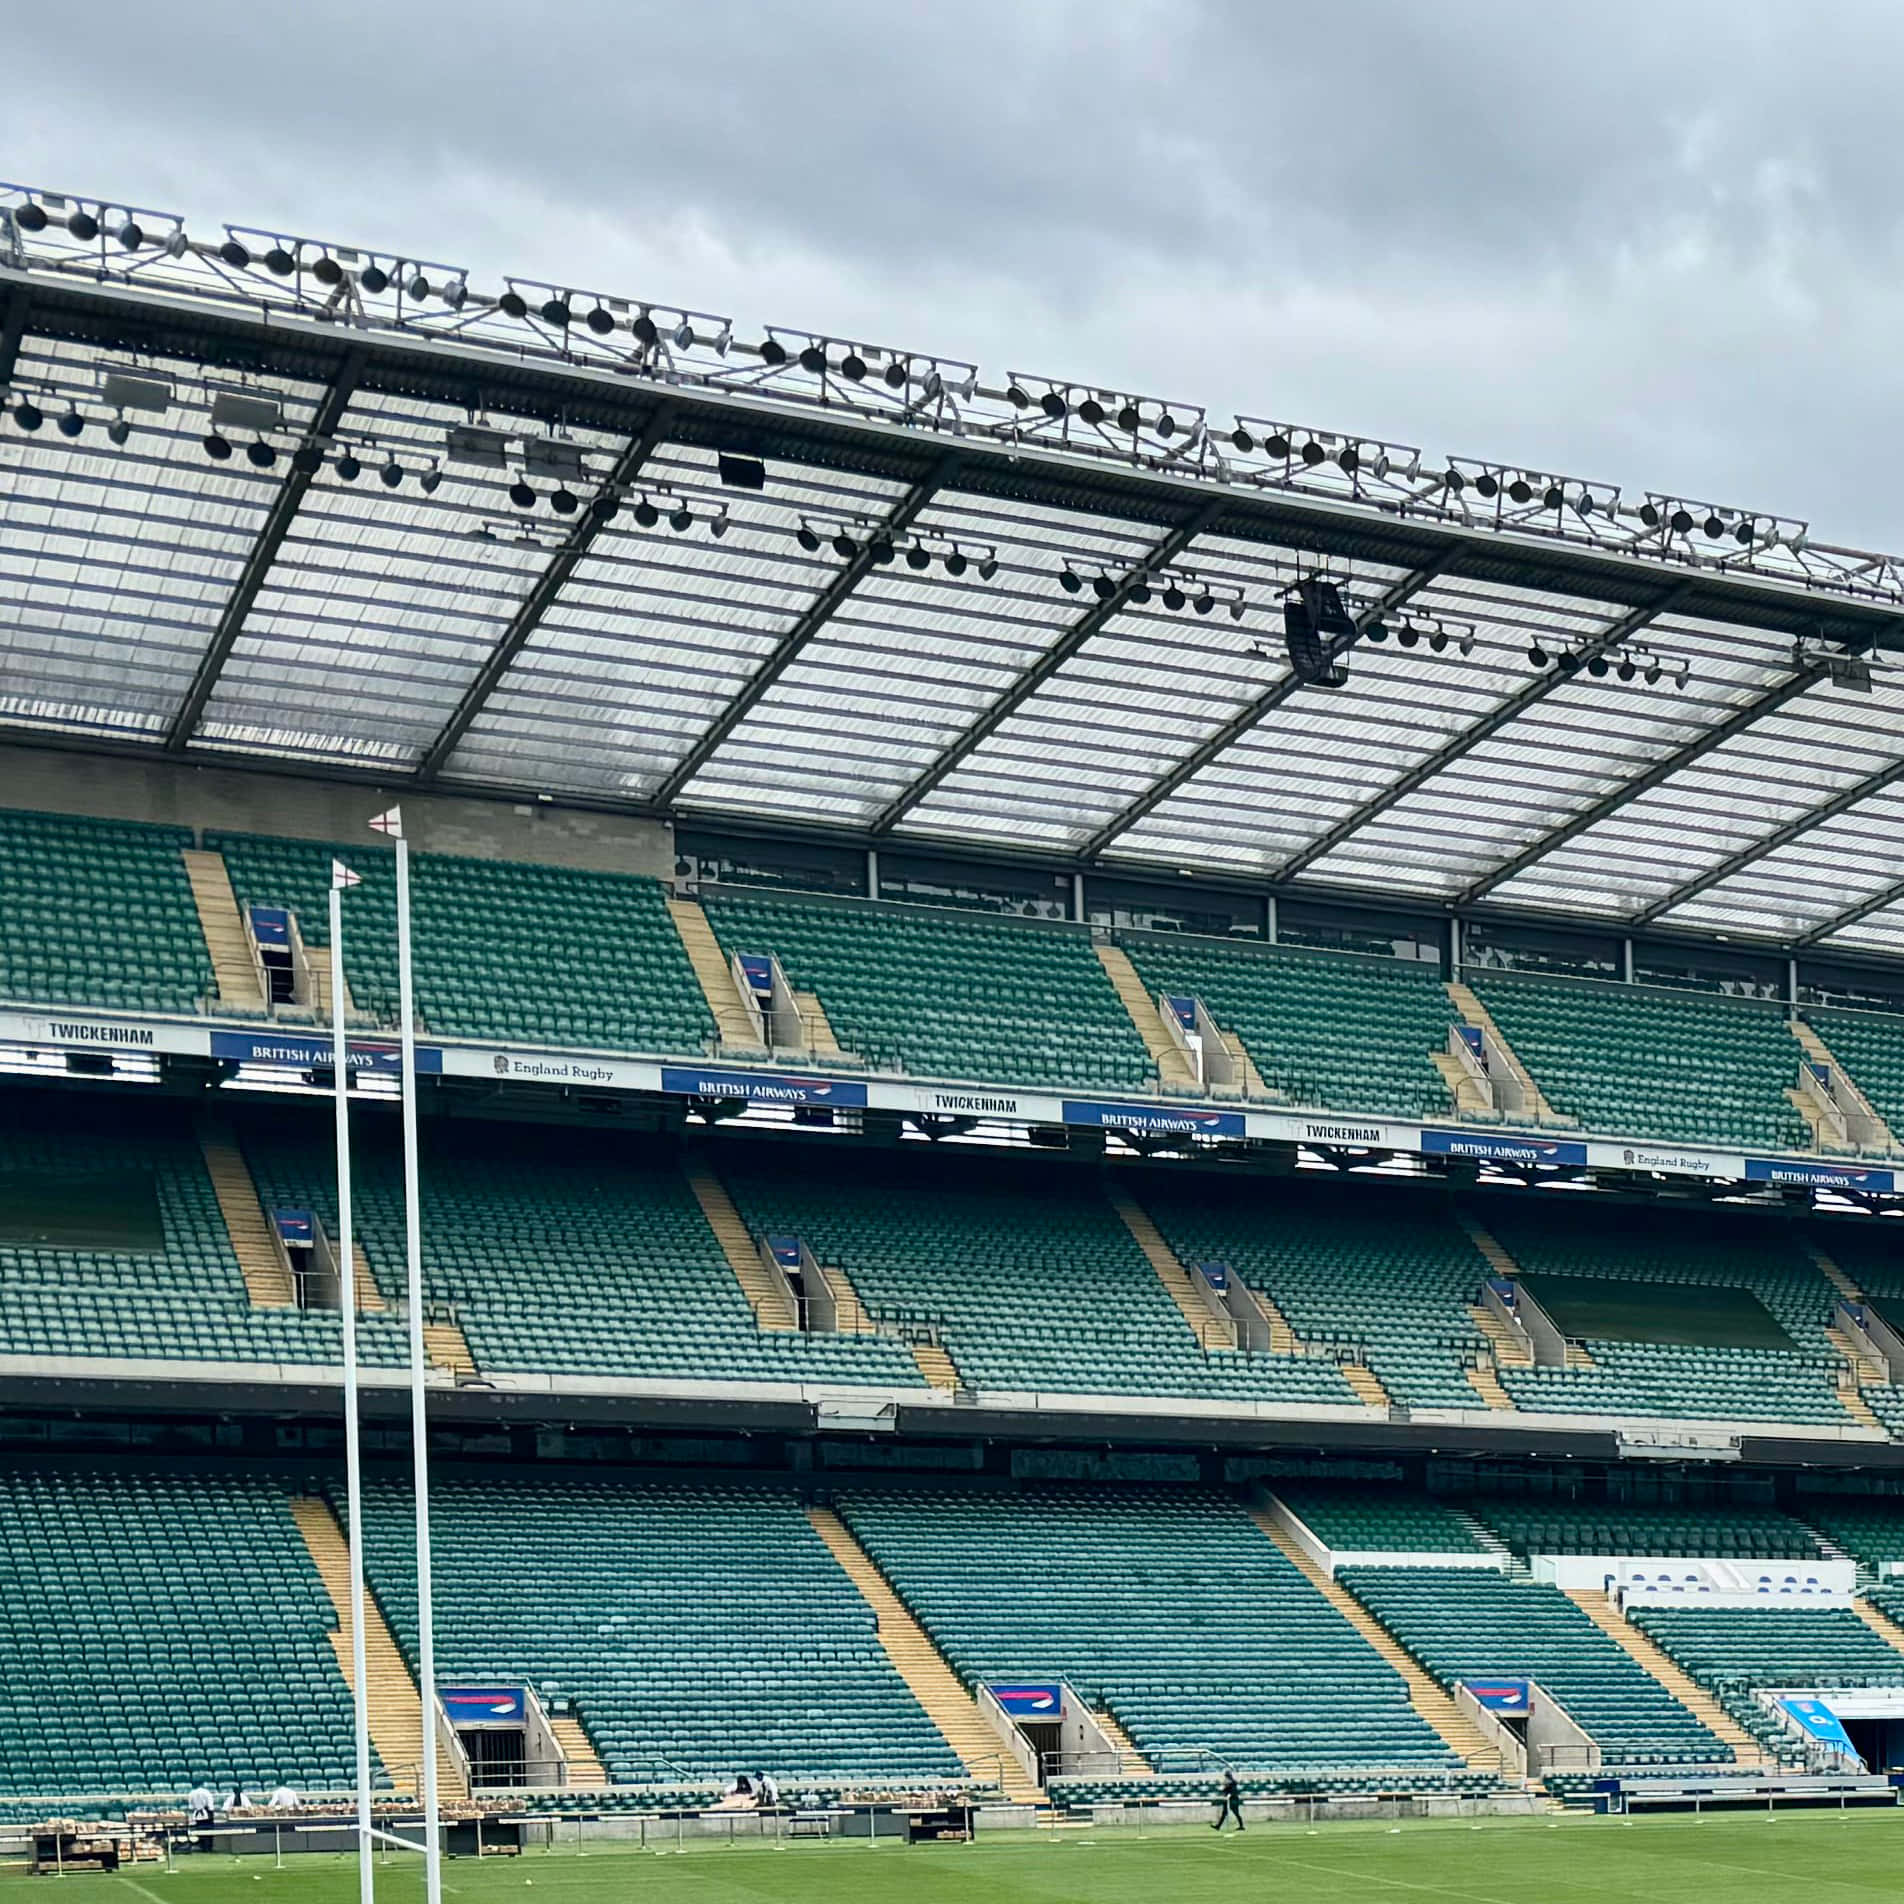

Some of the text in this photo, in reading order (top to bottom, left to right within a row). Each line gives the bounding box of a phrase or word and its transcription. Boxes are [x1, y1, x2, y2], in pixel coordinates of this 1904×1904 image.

[49, 1022, 154, 1045] TWICKENHAM
[252, 1046, 374, 1067] BRITISH AIRAYS
[513, 1062, 614, 1081] England Rugby
[698, 1081, 807, 1101] BRITISH AIRWAYS
[935, 1094, 1017, 1113] TWICKENHAM
[1101, 1113, 1198, 1131] BRITISH AIRWAYS
[1306, 1124, 1380, 1142] TWICKENHAM
[1450, 1143, 1537, 1160] BRITISH AIRWAYS
[1637, 1154, 1710, 1171] England Rugby
[1771, 1170, 1849, 1186] BRITISH AIRWAYS
